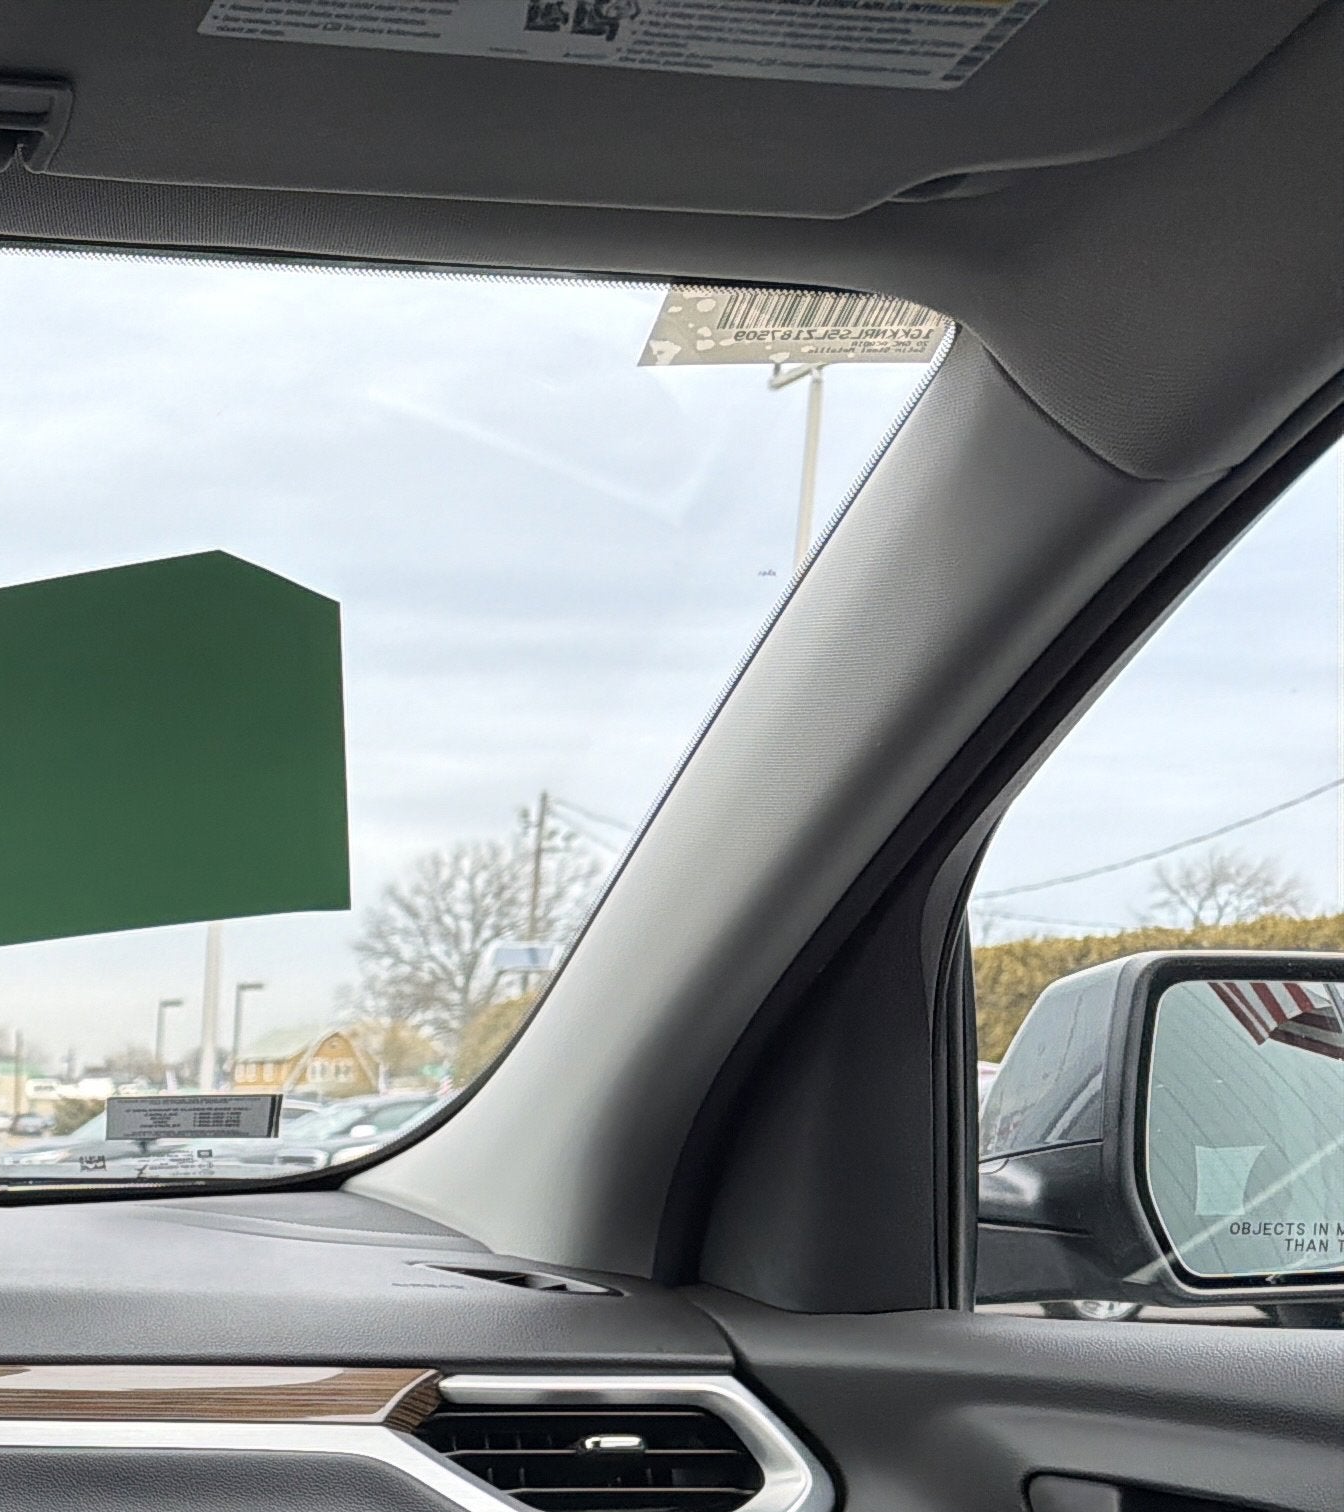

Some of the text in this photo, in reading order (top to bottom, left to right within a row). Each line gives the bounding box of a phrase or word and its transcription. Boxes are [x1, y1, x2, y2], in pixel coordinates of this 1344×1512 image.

[1229, 1221, 1306, 1236] OBJECTS
[1313, 1222, 1329, 1237] IN
[1284, 1238, 1329, 1253] THAN
